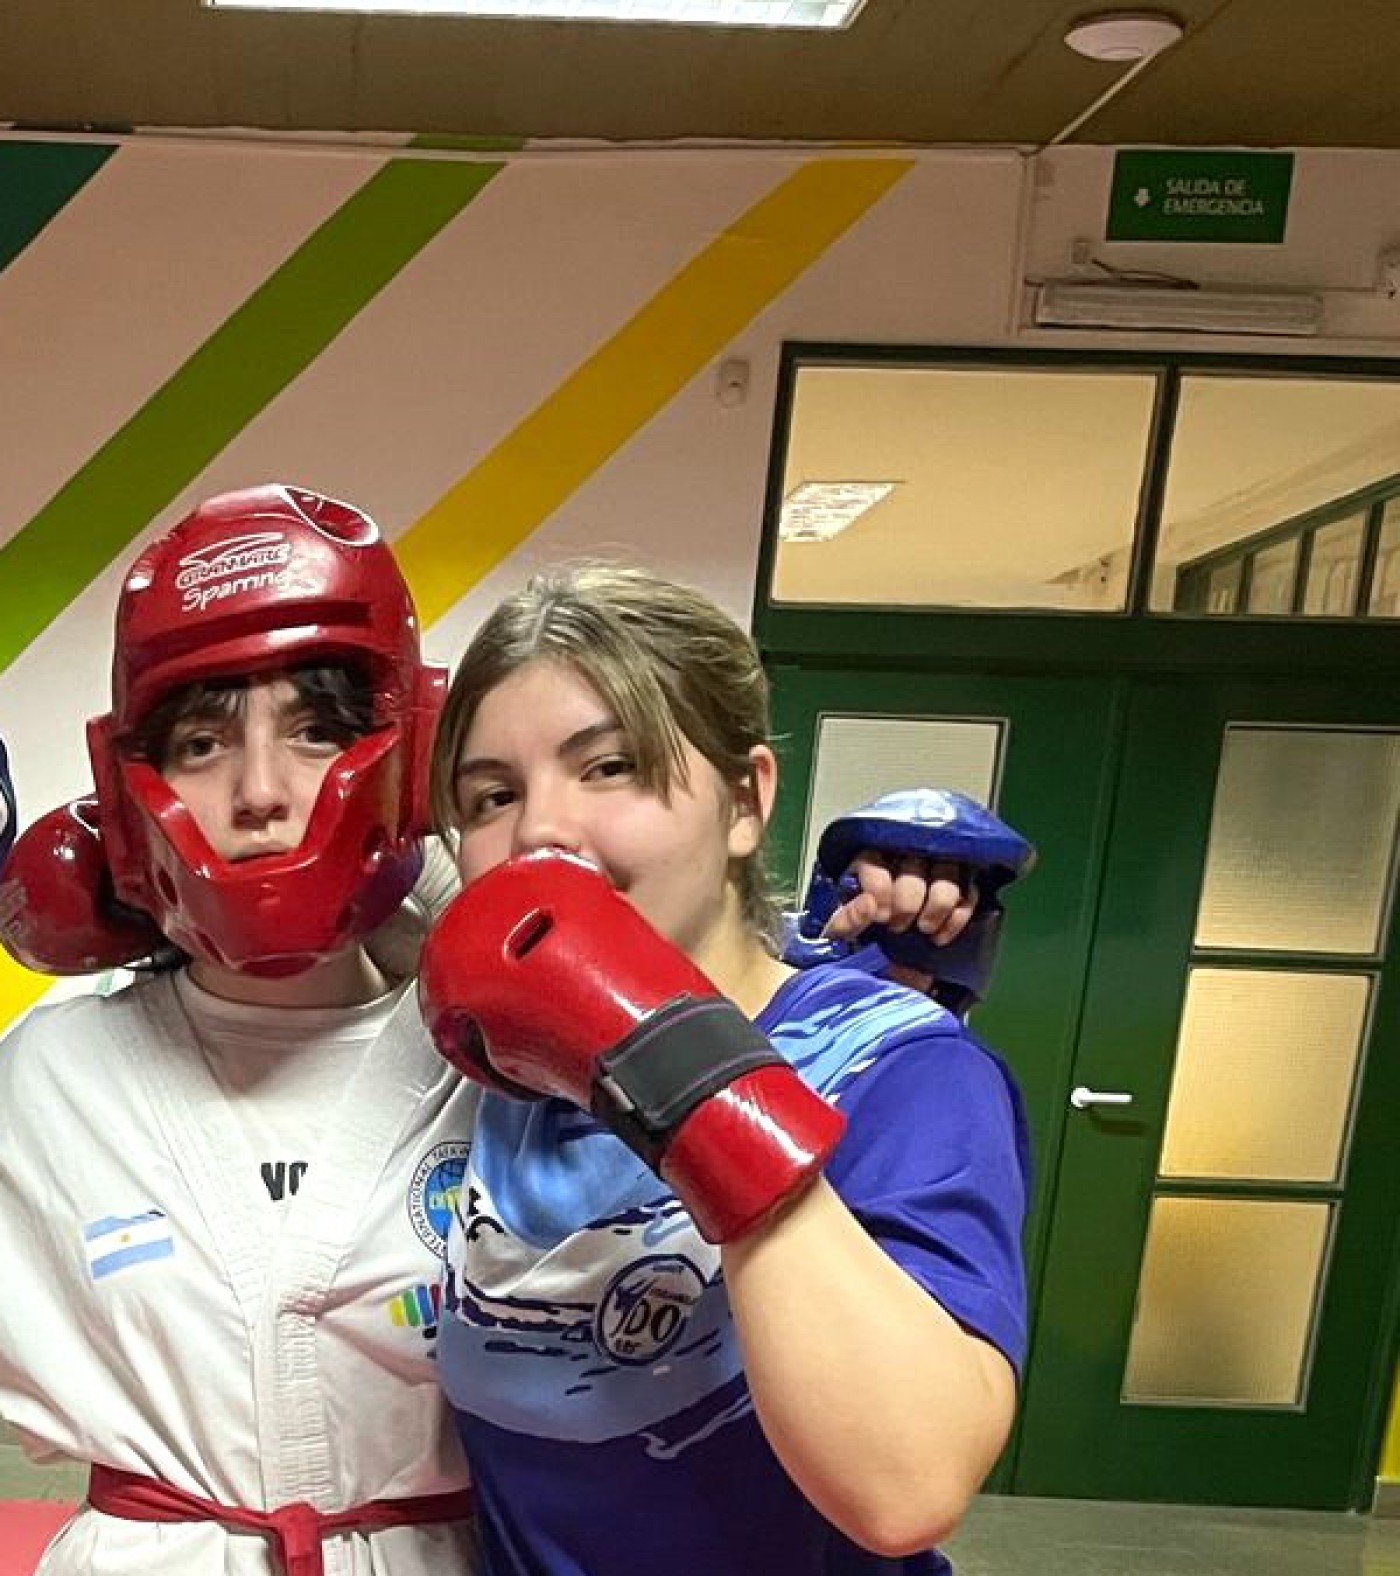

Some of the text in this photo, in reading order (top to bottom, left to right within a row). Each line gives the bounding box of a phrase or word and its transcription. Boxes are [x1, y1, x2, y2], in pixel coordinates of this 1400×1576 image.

[1166, 179, 1247, 196] SALIDA DE
[1163, 199, 1264, 216] EMERGENCIA
